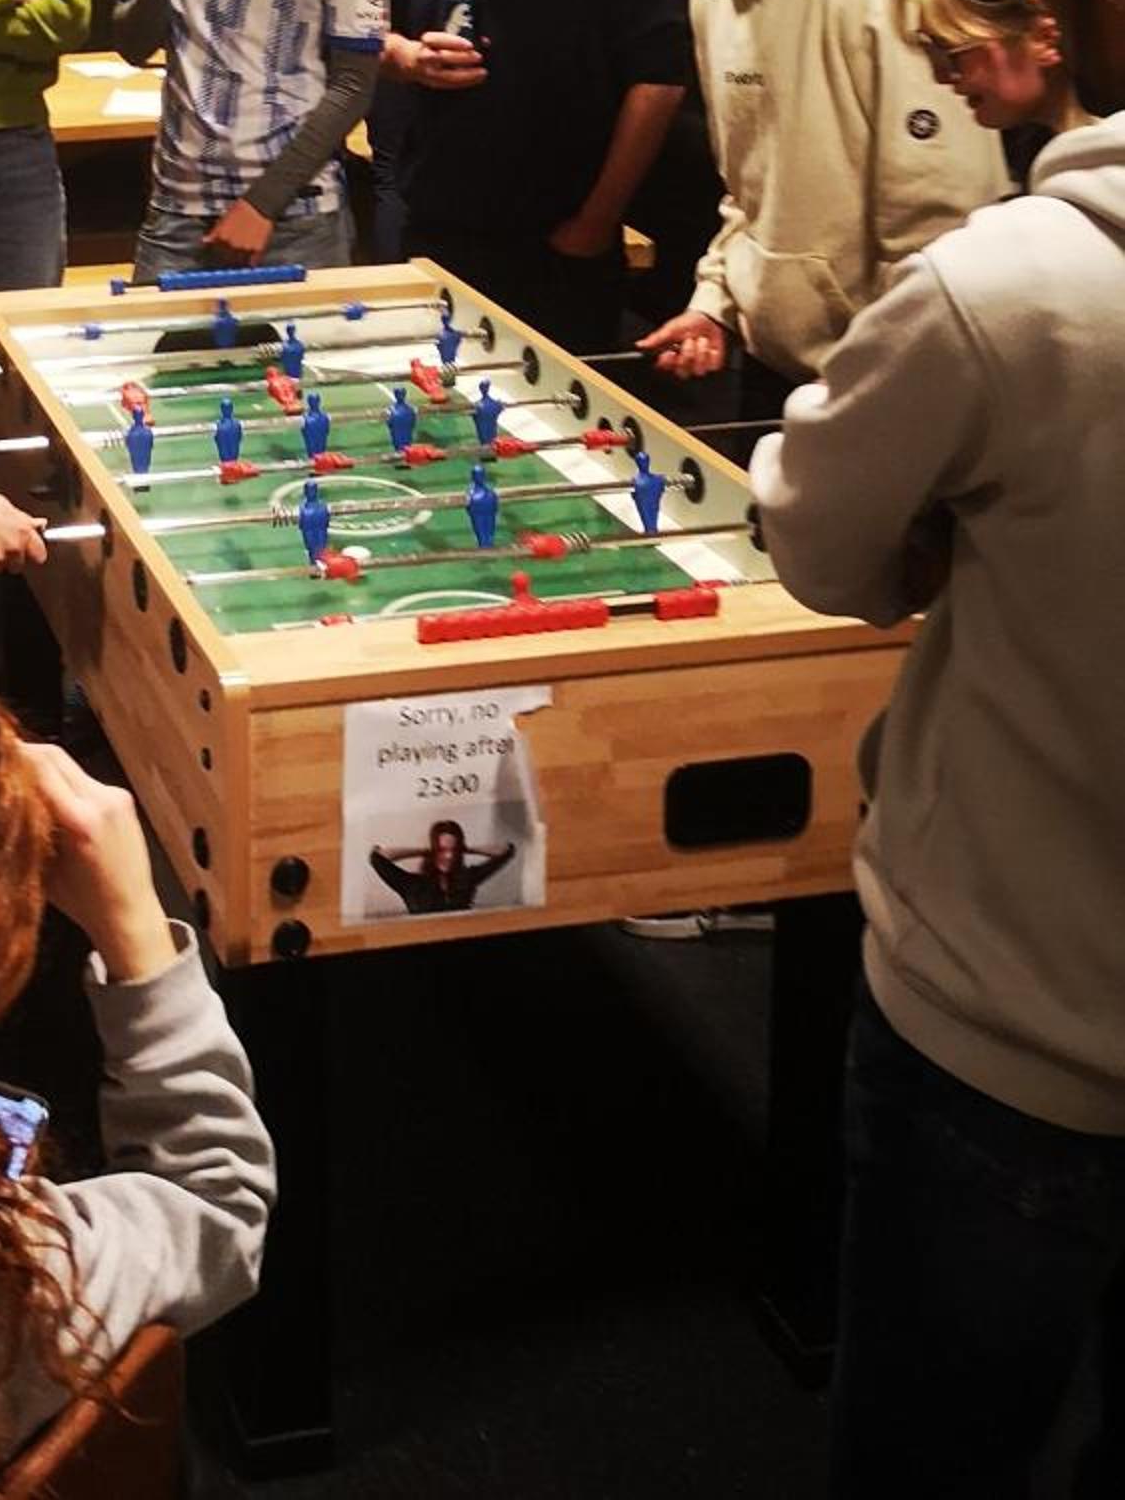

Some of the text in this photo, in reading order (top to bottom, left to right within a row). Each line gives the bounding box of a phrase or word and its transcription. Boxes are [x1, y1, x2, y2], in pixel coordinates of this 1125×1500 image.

[398, 703, 499, 727] Sorry, no
[378, 740, 458, 768] playing
[416, 773, 479, 797] 23:00
